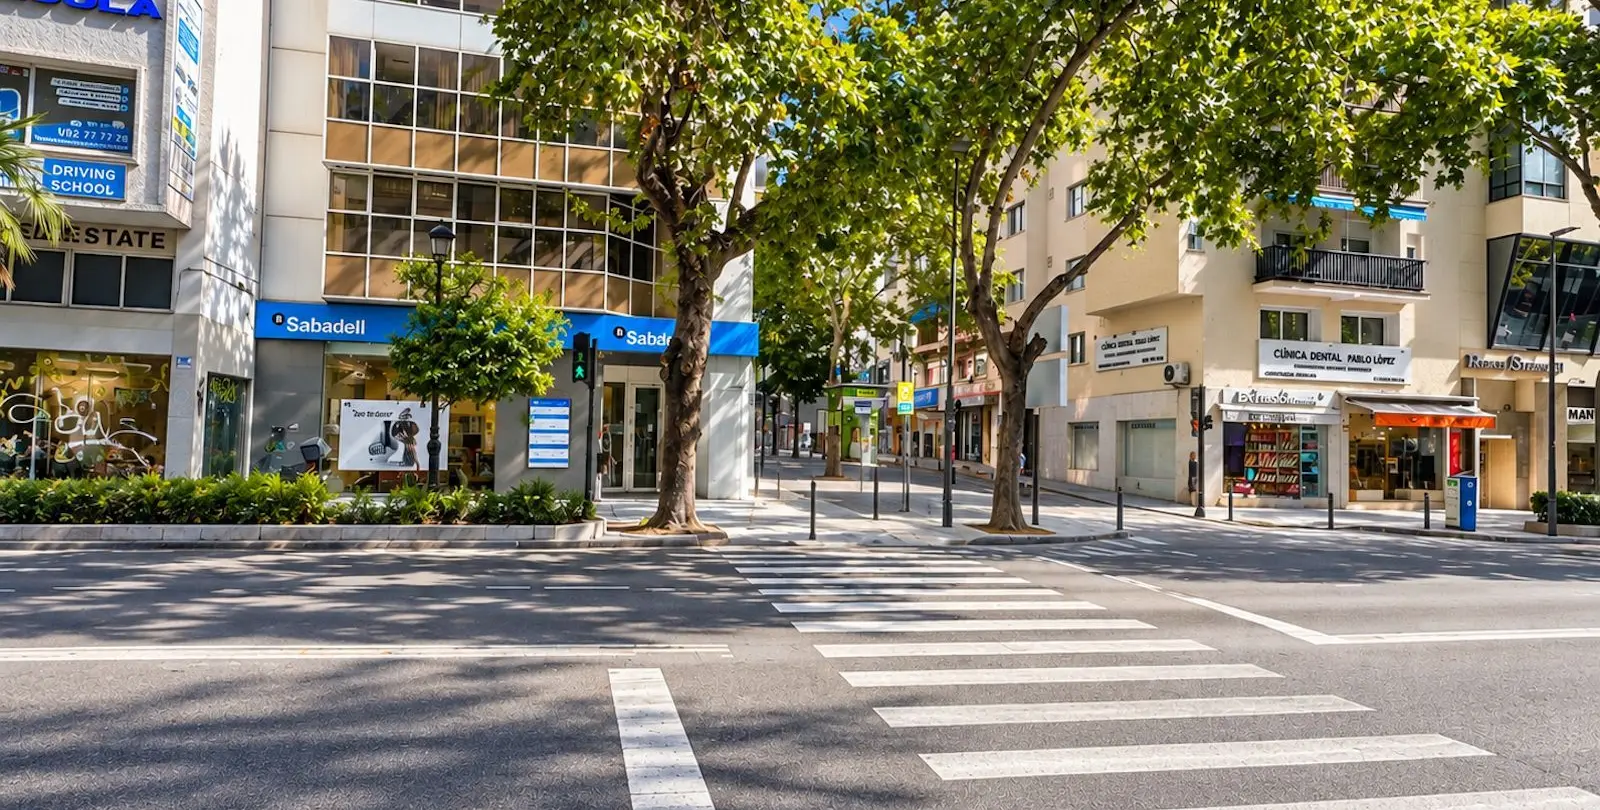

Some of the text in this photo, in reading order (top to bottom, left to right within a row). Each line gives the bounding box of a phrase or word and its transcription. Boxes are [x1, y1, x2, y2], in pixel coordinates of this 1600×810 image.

[52, 164, 116, 181] DRIVING
[51, 180, 114, 196] SCHOOL
[286, 316, 366, 335] Sabadell
[1273, 347, 1307, 360] CLÍNICA
[1310, 351, 1342, 362] DENTAL
[1347, 354, 1371, 364] PABLO
[1568, 409, 1594, 421] MAN
